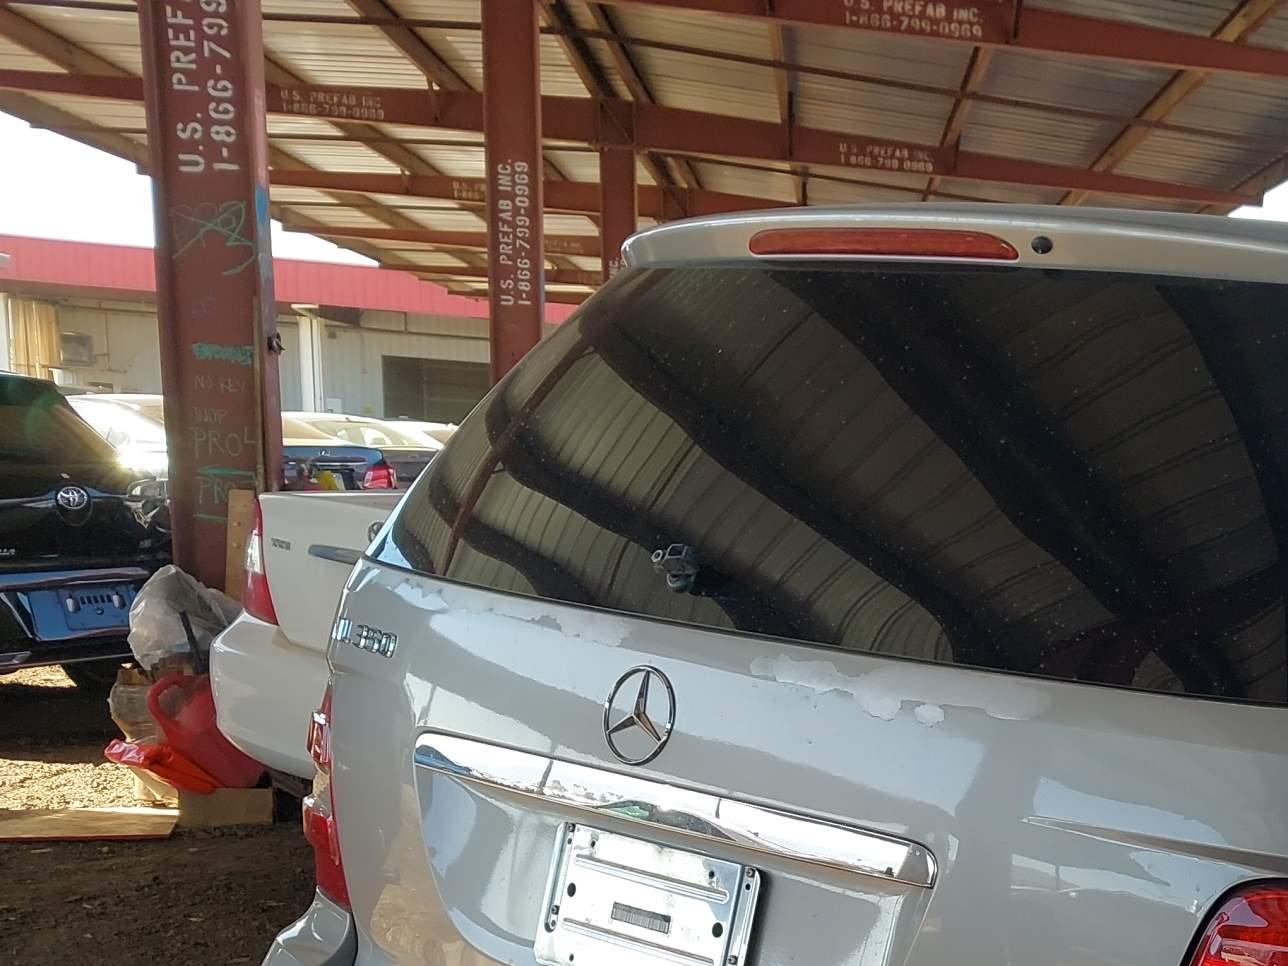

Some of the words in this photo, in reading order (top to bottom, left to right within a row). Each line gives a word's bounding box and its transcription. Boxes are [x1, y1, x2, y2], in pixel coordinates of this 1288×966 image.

[845, 11, 982, 38] 1-866-799-0969
[882, 0, 946, 18] PREFAB
[952, 7, 984, 23] INC.
[176, 112, 206, 173] U.S.
[497, 159, 512, 191] INC.
[499, 199, 513, 265] PREFAB
[514, 161, 532, 305] 1-866-799-0969
[500, 274, 515, 306] U.S.
